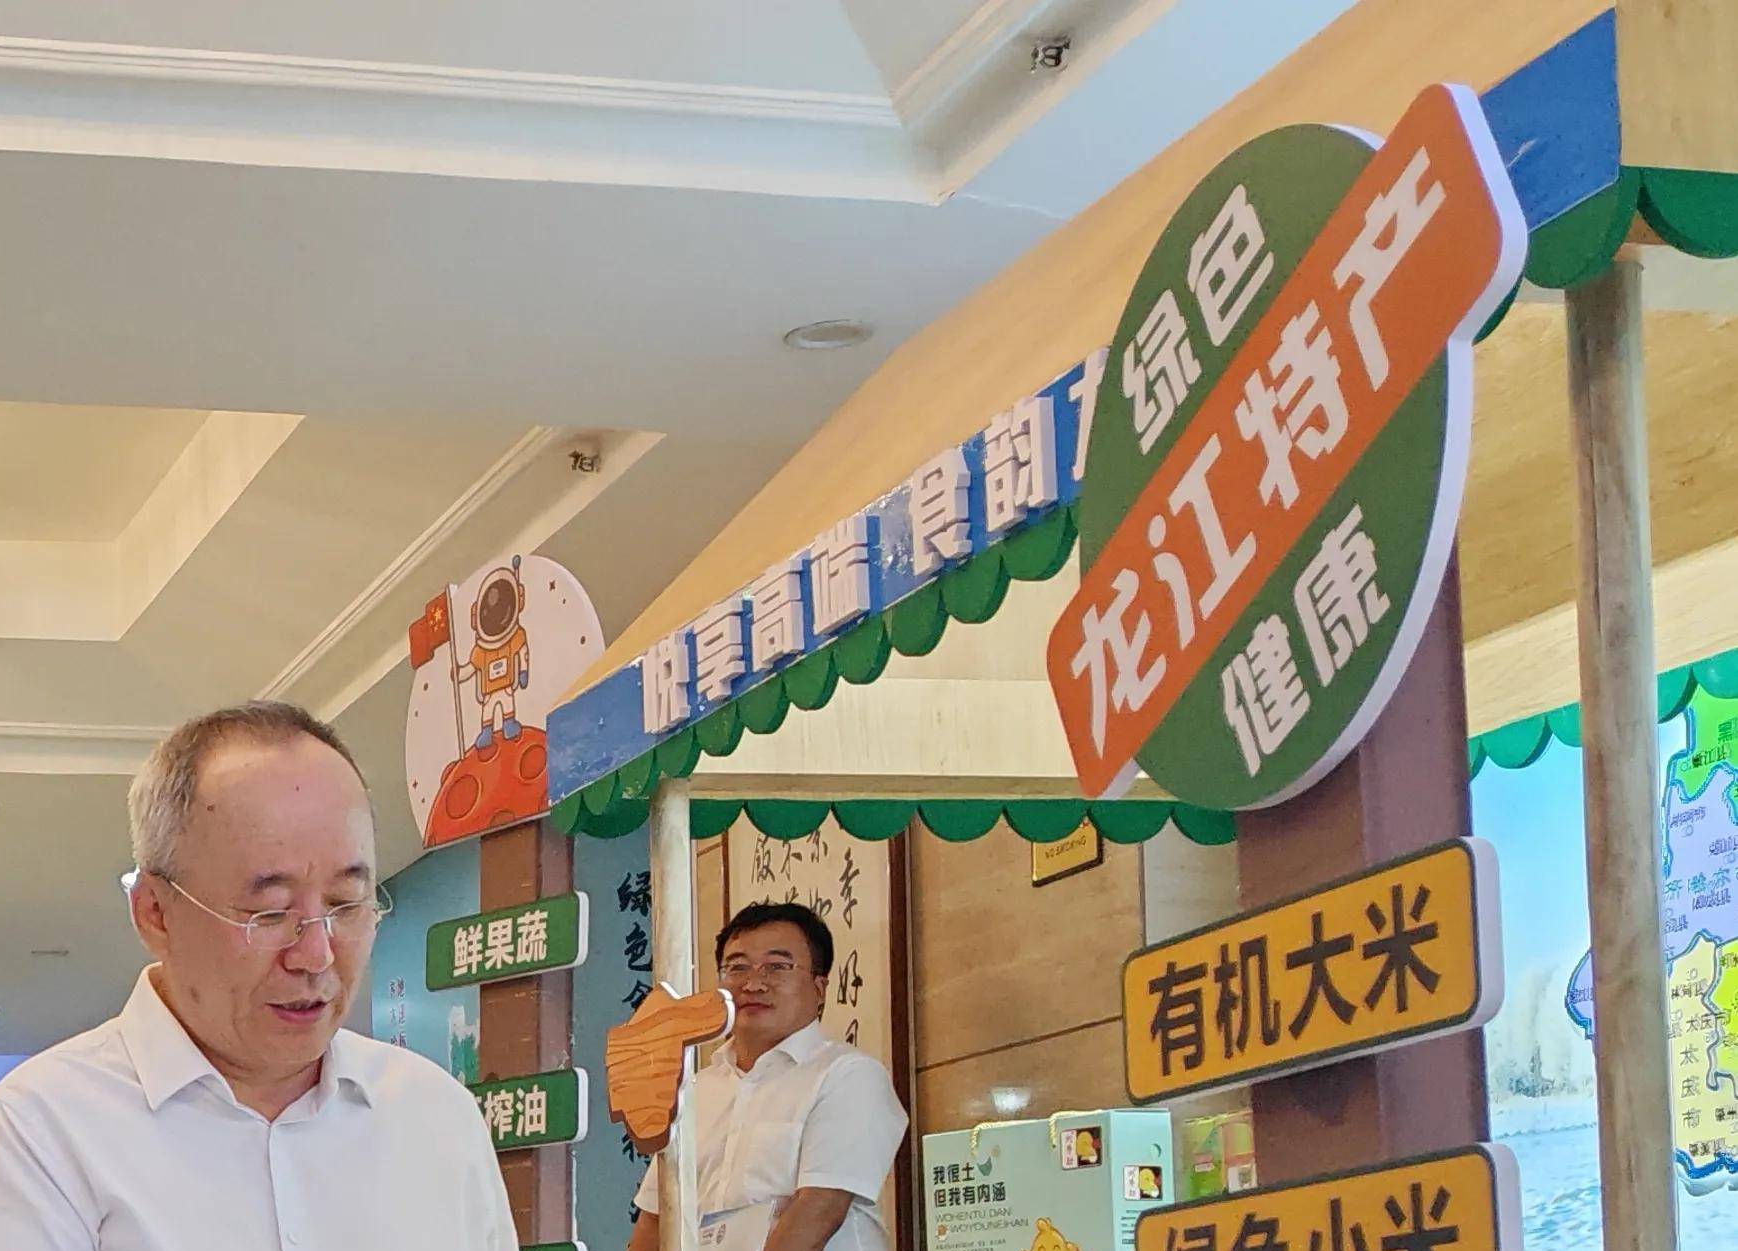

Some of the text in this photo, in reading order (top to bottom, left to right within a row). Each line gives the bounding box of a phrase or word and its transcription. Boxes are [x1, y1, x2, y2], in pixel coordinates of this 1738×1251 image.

[1123, 184, 1275, 456] 绿色
[1070, 145, 1448, 757] 龙江特产
[640, 513, 871, 735] 悦享高端
[1221, 505, 1392, 778] 健康
[452, 909, 550, 977] 鲜果蔬
[1147, 882, 1442, 1077] 有机大米
[472, 1083, 548, 1141] 榨油
[933, 1162, 975, 1185] 我很土
[934, 1181, 1006, 1208] 但我有内涵
